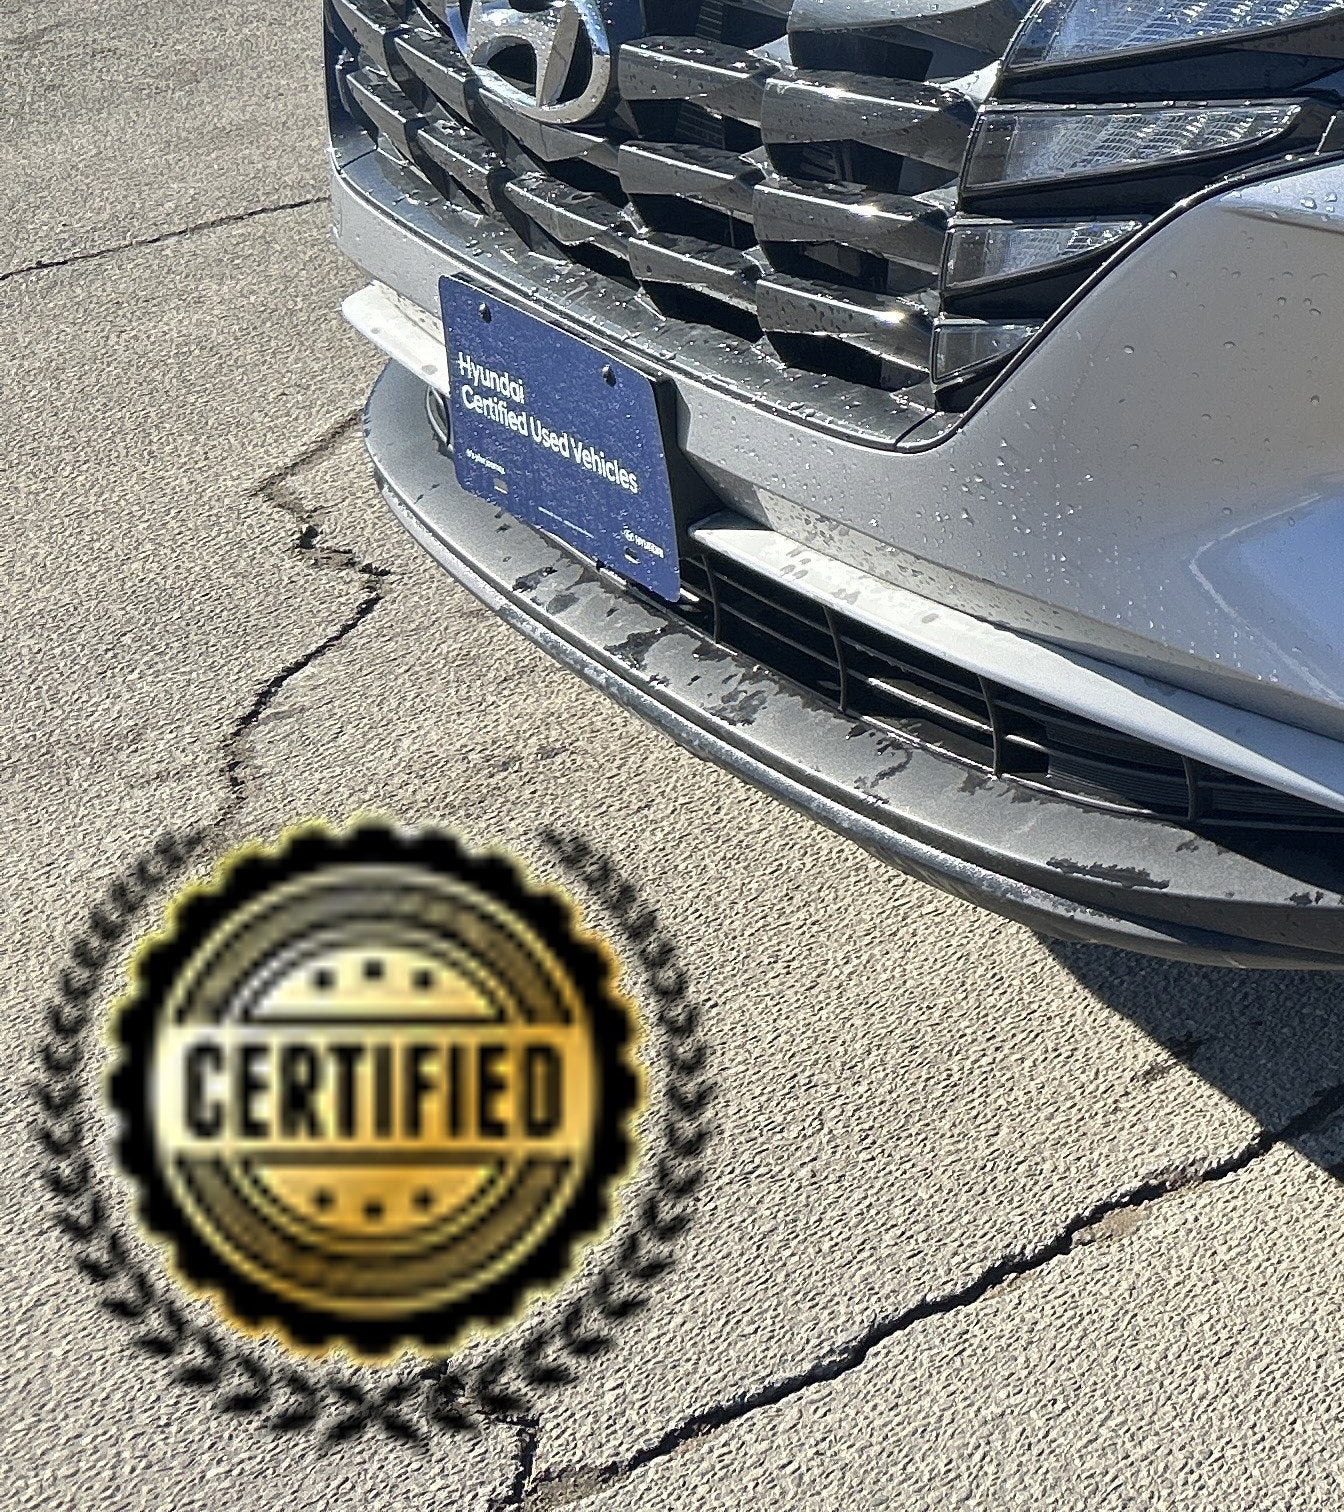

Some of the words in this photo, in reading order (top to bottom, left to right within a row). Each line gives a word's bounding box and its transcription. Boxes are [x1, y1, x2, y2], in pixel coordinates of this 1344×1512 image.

[456, 351, 526, 405] Hyundai
[461, 384, 528, 437] Certified
[529, 419, 569, 458] Used
[570, 437, 639, 494] Vehicles
